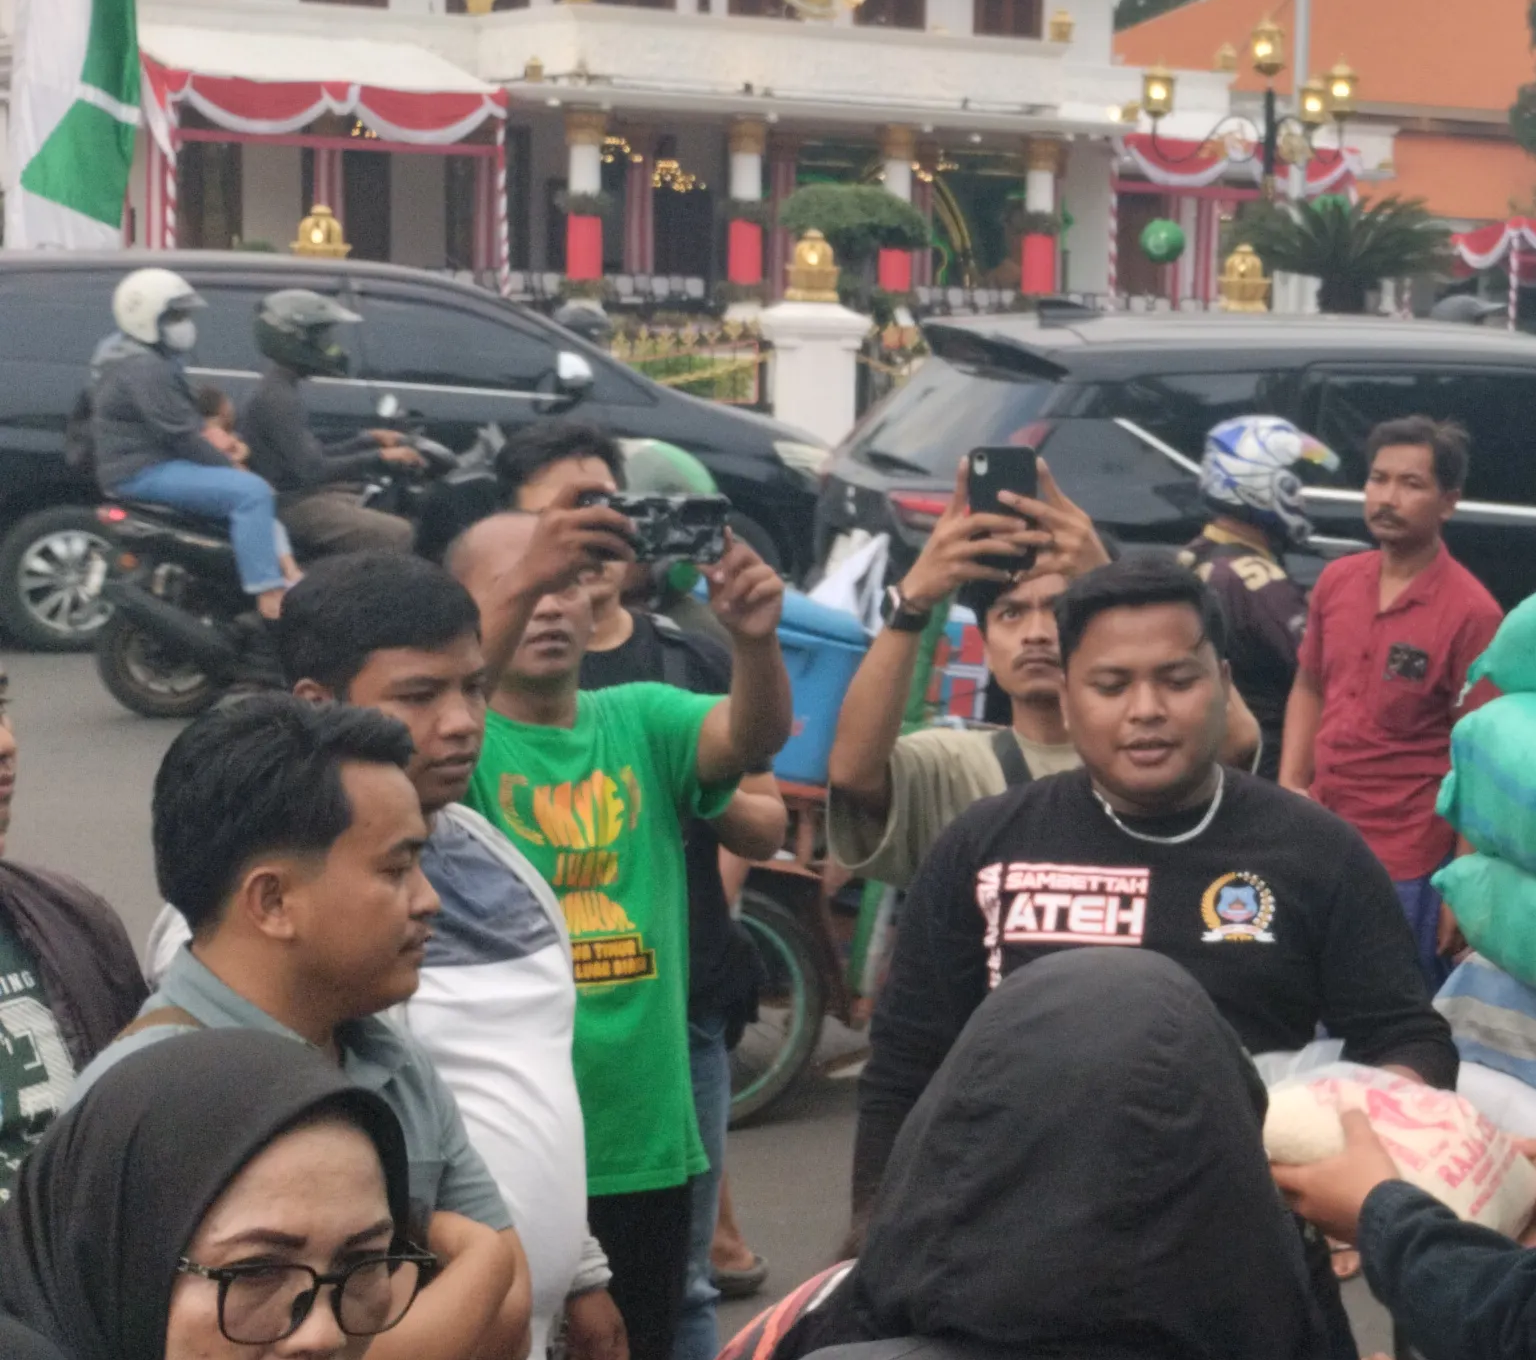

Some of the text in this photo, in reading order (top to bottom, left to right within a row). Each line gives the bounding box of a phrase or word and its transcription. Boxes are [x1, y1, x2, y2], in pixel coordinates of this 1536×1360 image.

[1004, 870, 1149, 895] SAMBETTAH
[1003, 891, 1147, 937] ATEH
[0, 970, 36, 995] ING
